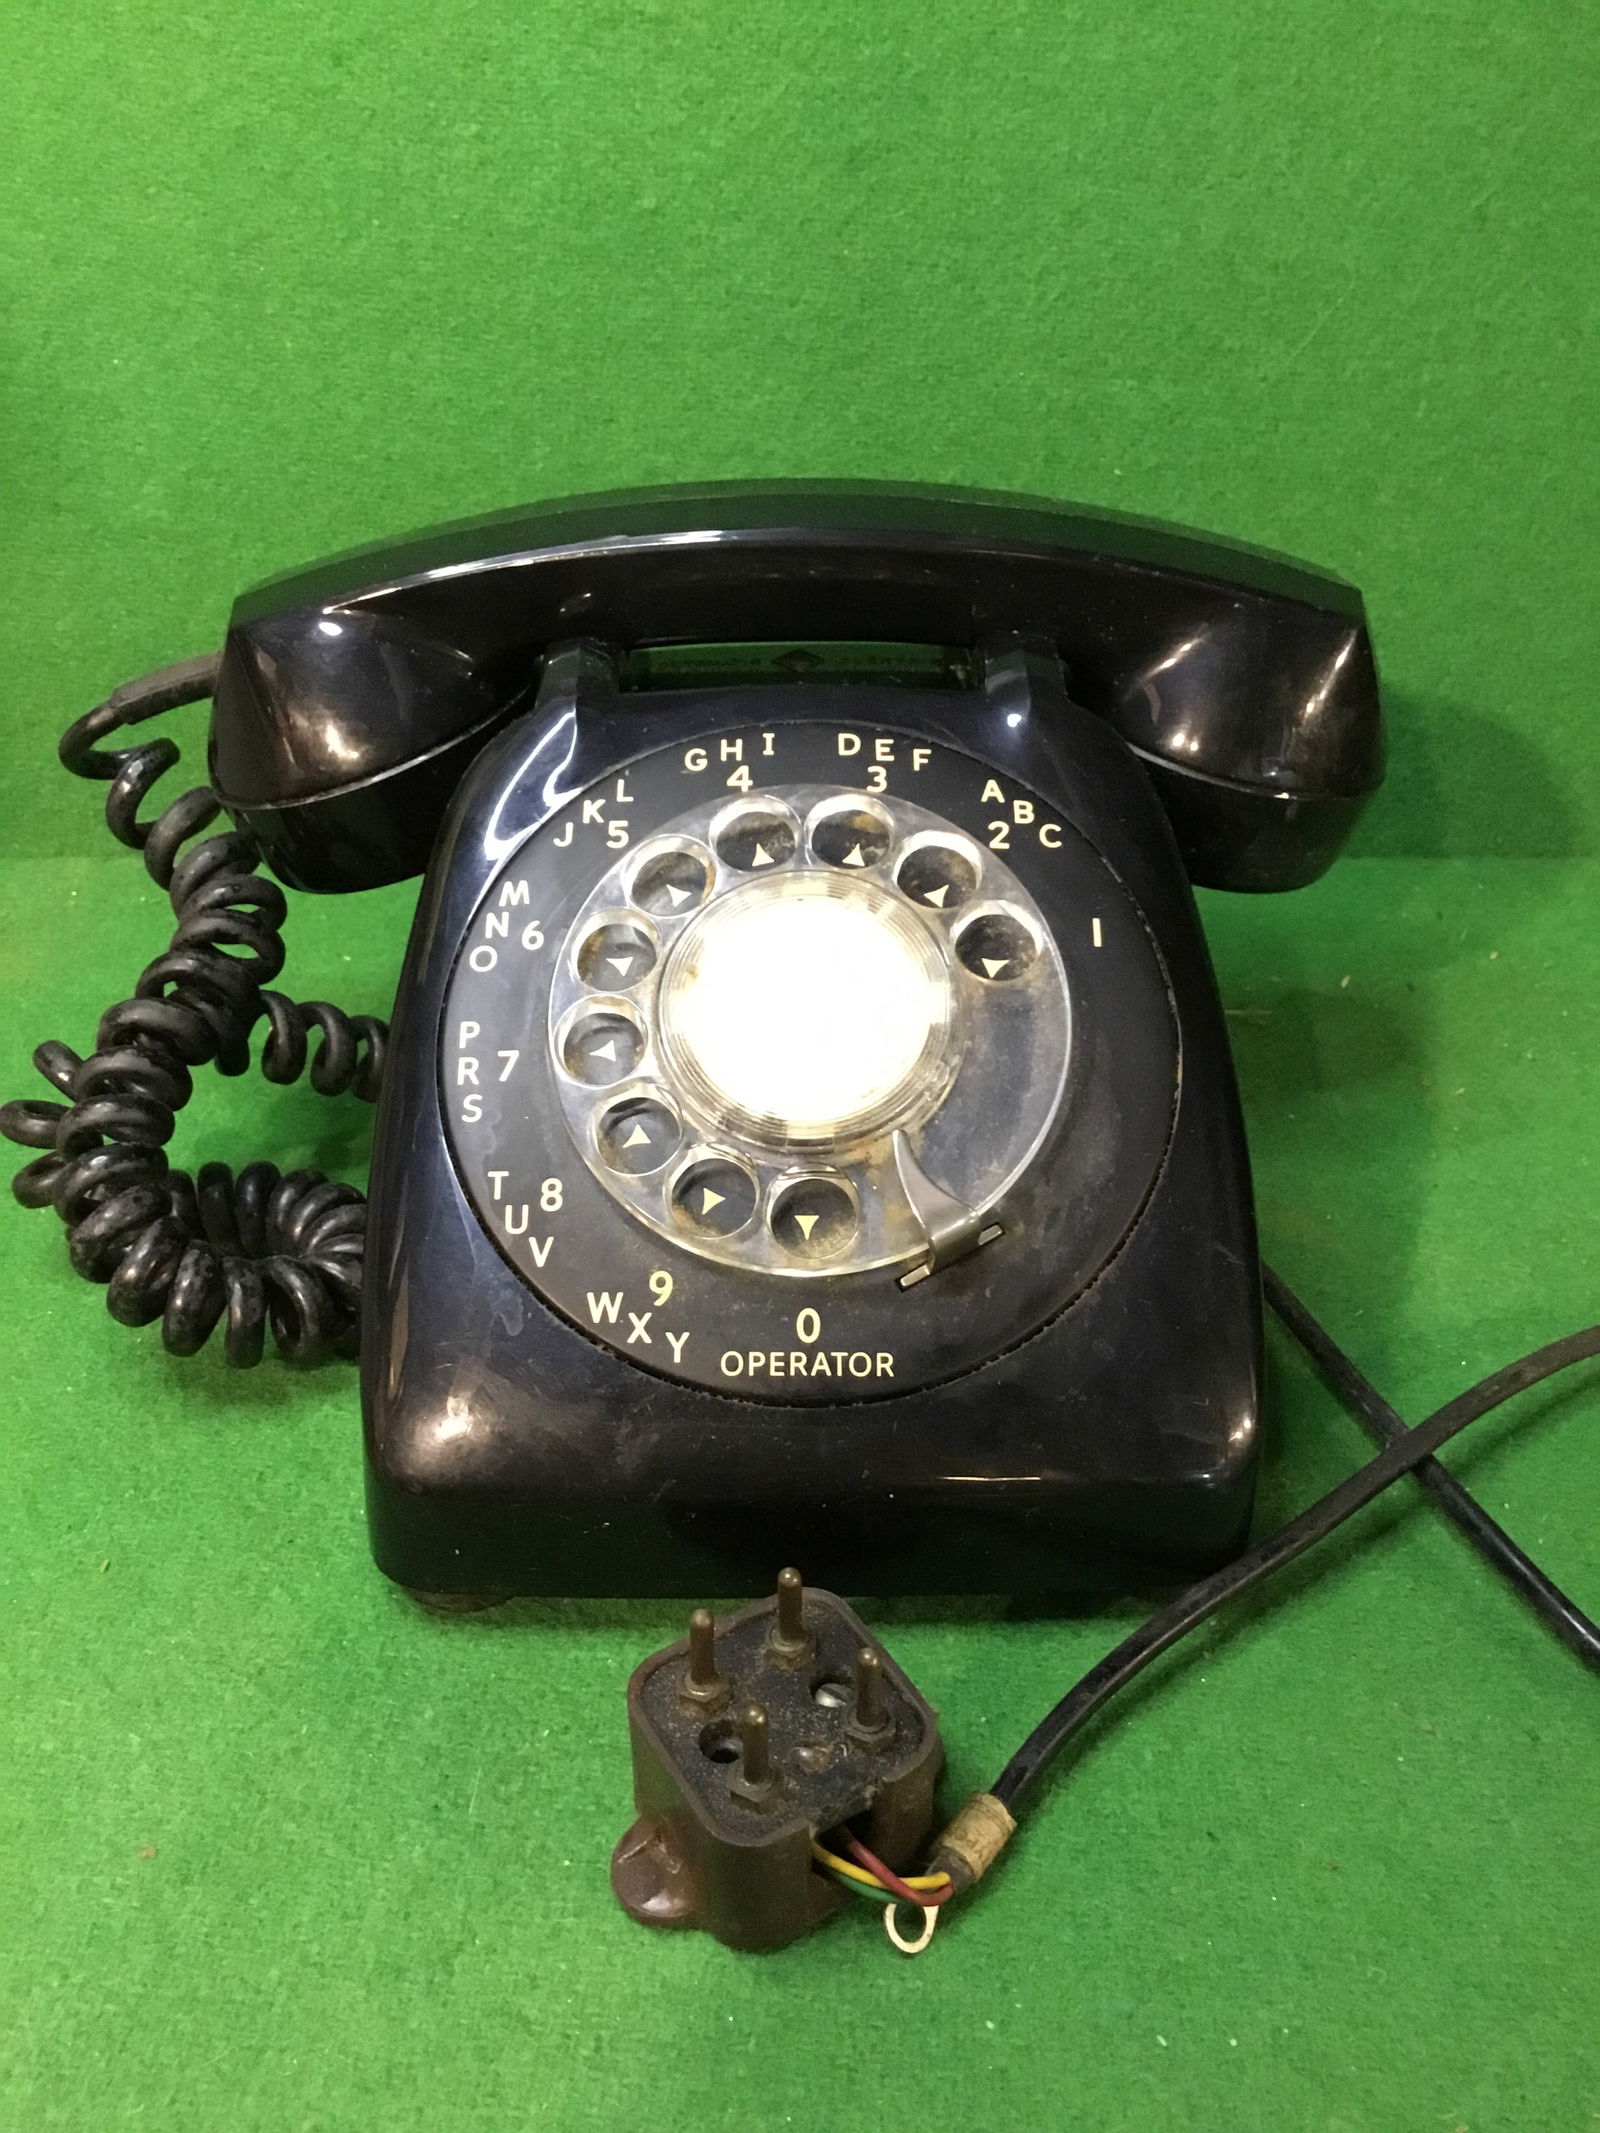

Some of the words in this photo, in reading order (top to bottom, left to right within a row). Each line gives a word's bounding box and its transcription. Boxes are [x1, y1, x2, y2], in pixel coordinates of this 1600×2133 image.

[727, 765, 753, 792] 4
[867, 766, 888, 792] 3
[606, 820, 629, 848] 5
[988, 821, 1010, 849] 2
[521, 920, 544, 950] 6
[497, 1050, 519, 1081] 7
[540, 1177, 563, 1212] 8
[649, 1269, 674, 1306] 9
[720, 1351, 894, 1377] OPERATOR
